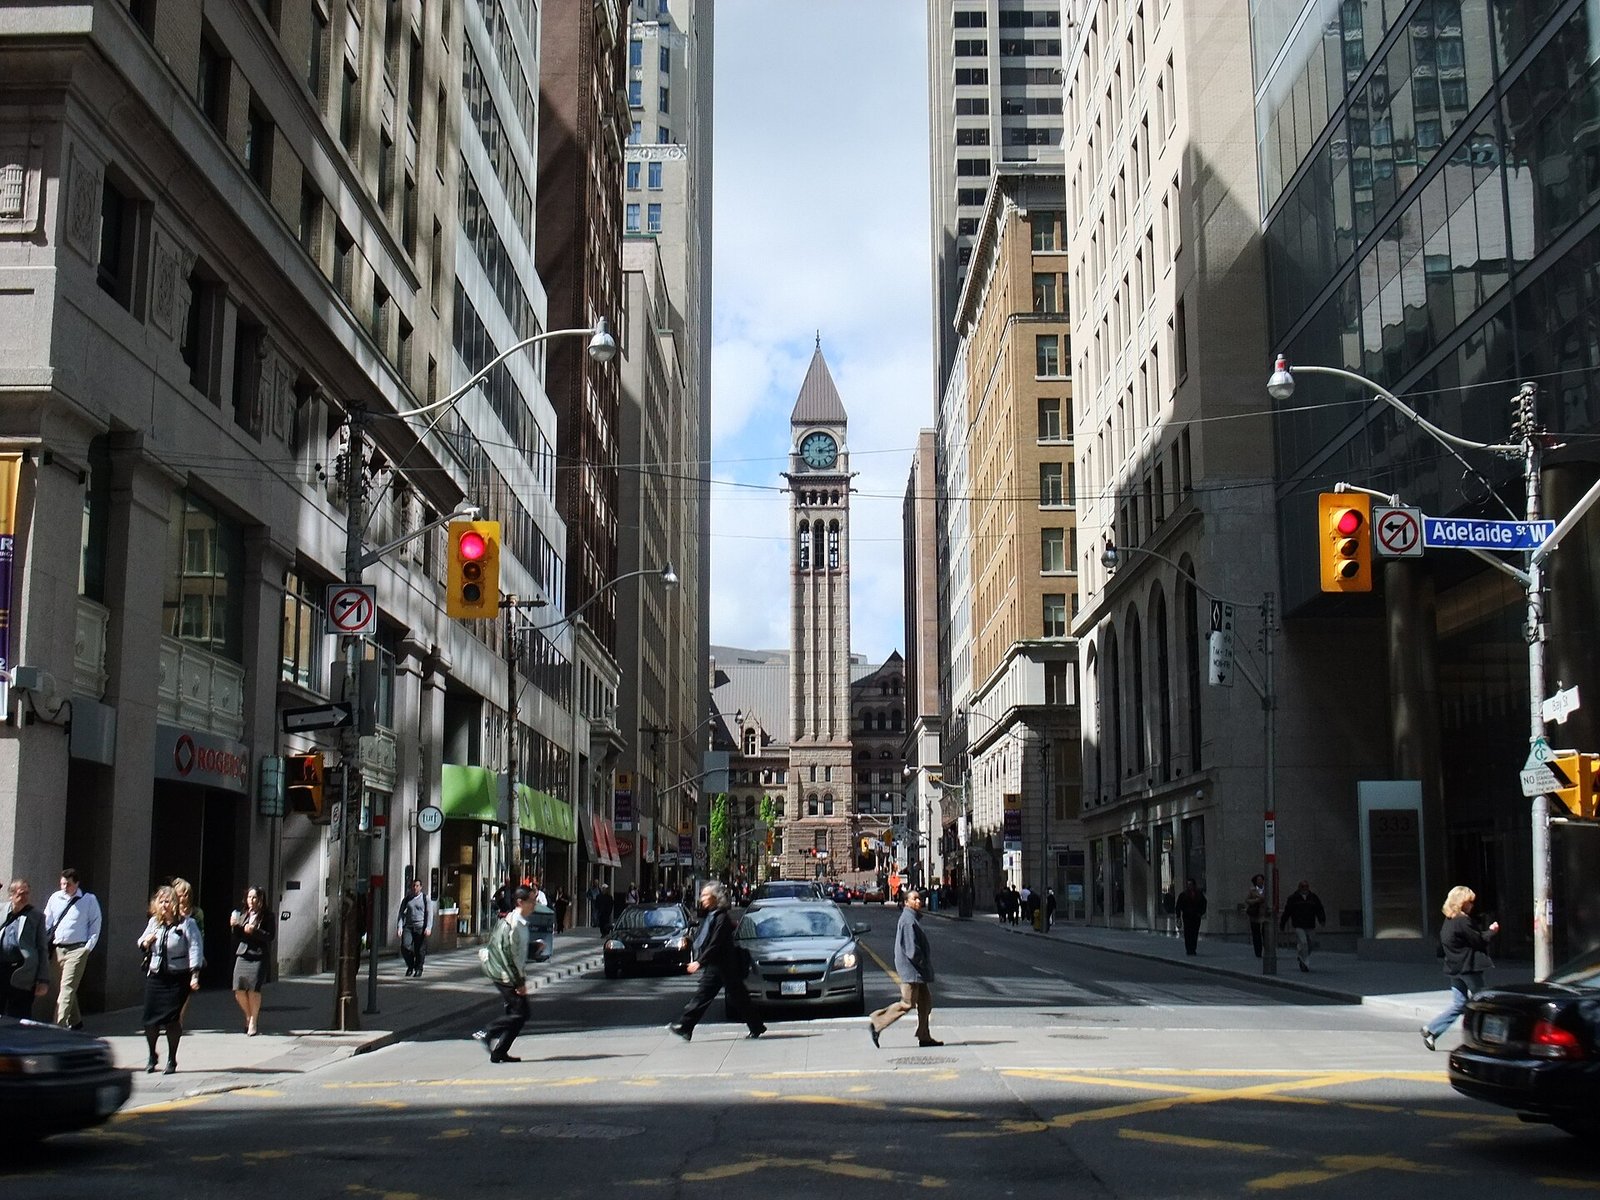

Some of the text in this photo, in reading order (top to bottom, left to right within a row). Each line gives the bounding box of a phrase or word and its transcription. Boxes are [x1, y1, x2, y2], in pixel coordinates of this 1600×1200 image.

[1432, 521, 1547, 543] Adelaide St W
[198, 746, 241, 778] ROGERS
[1523, 775, 1535, 786] NO
[422, 811, 439, 824] turf
[1378, 816, 1411, 832] 333
